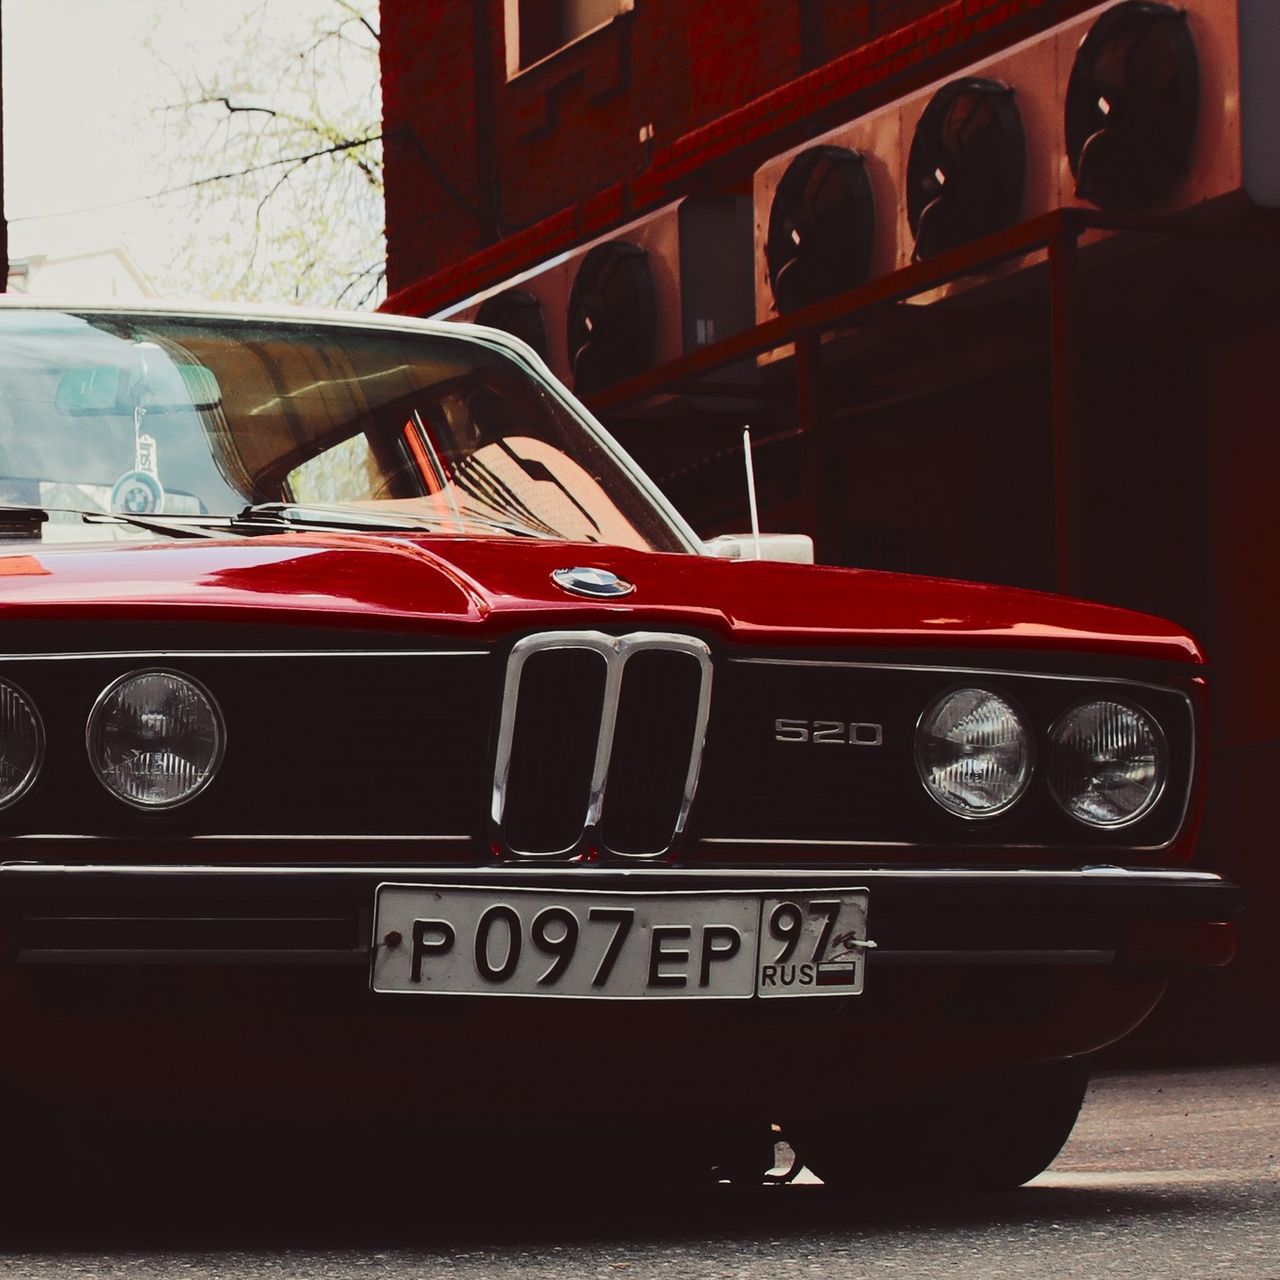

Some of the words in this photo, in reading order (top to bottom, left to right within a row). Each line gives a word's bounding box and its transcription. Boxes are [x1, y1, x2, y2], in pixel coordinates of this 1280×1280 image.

[775, 718, 883, 746] 520
[768, 900, 841, 964] 97
[761, 964, 814, 987] RUS
